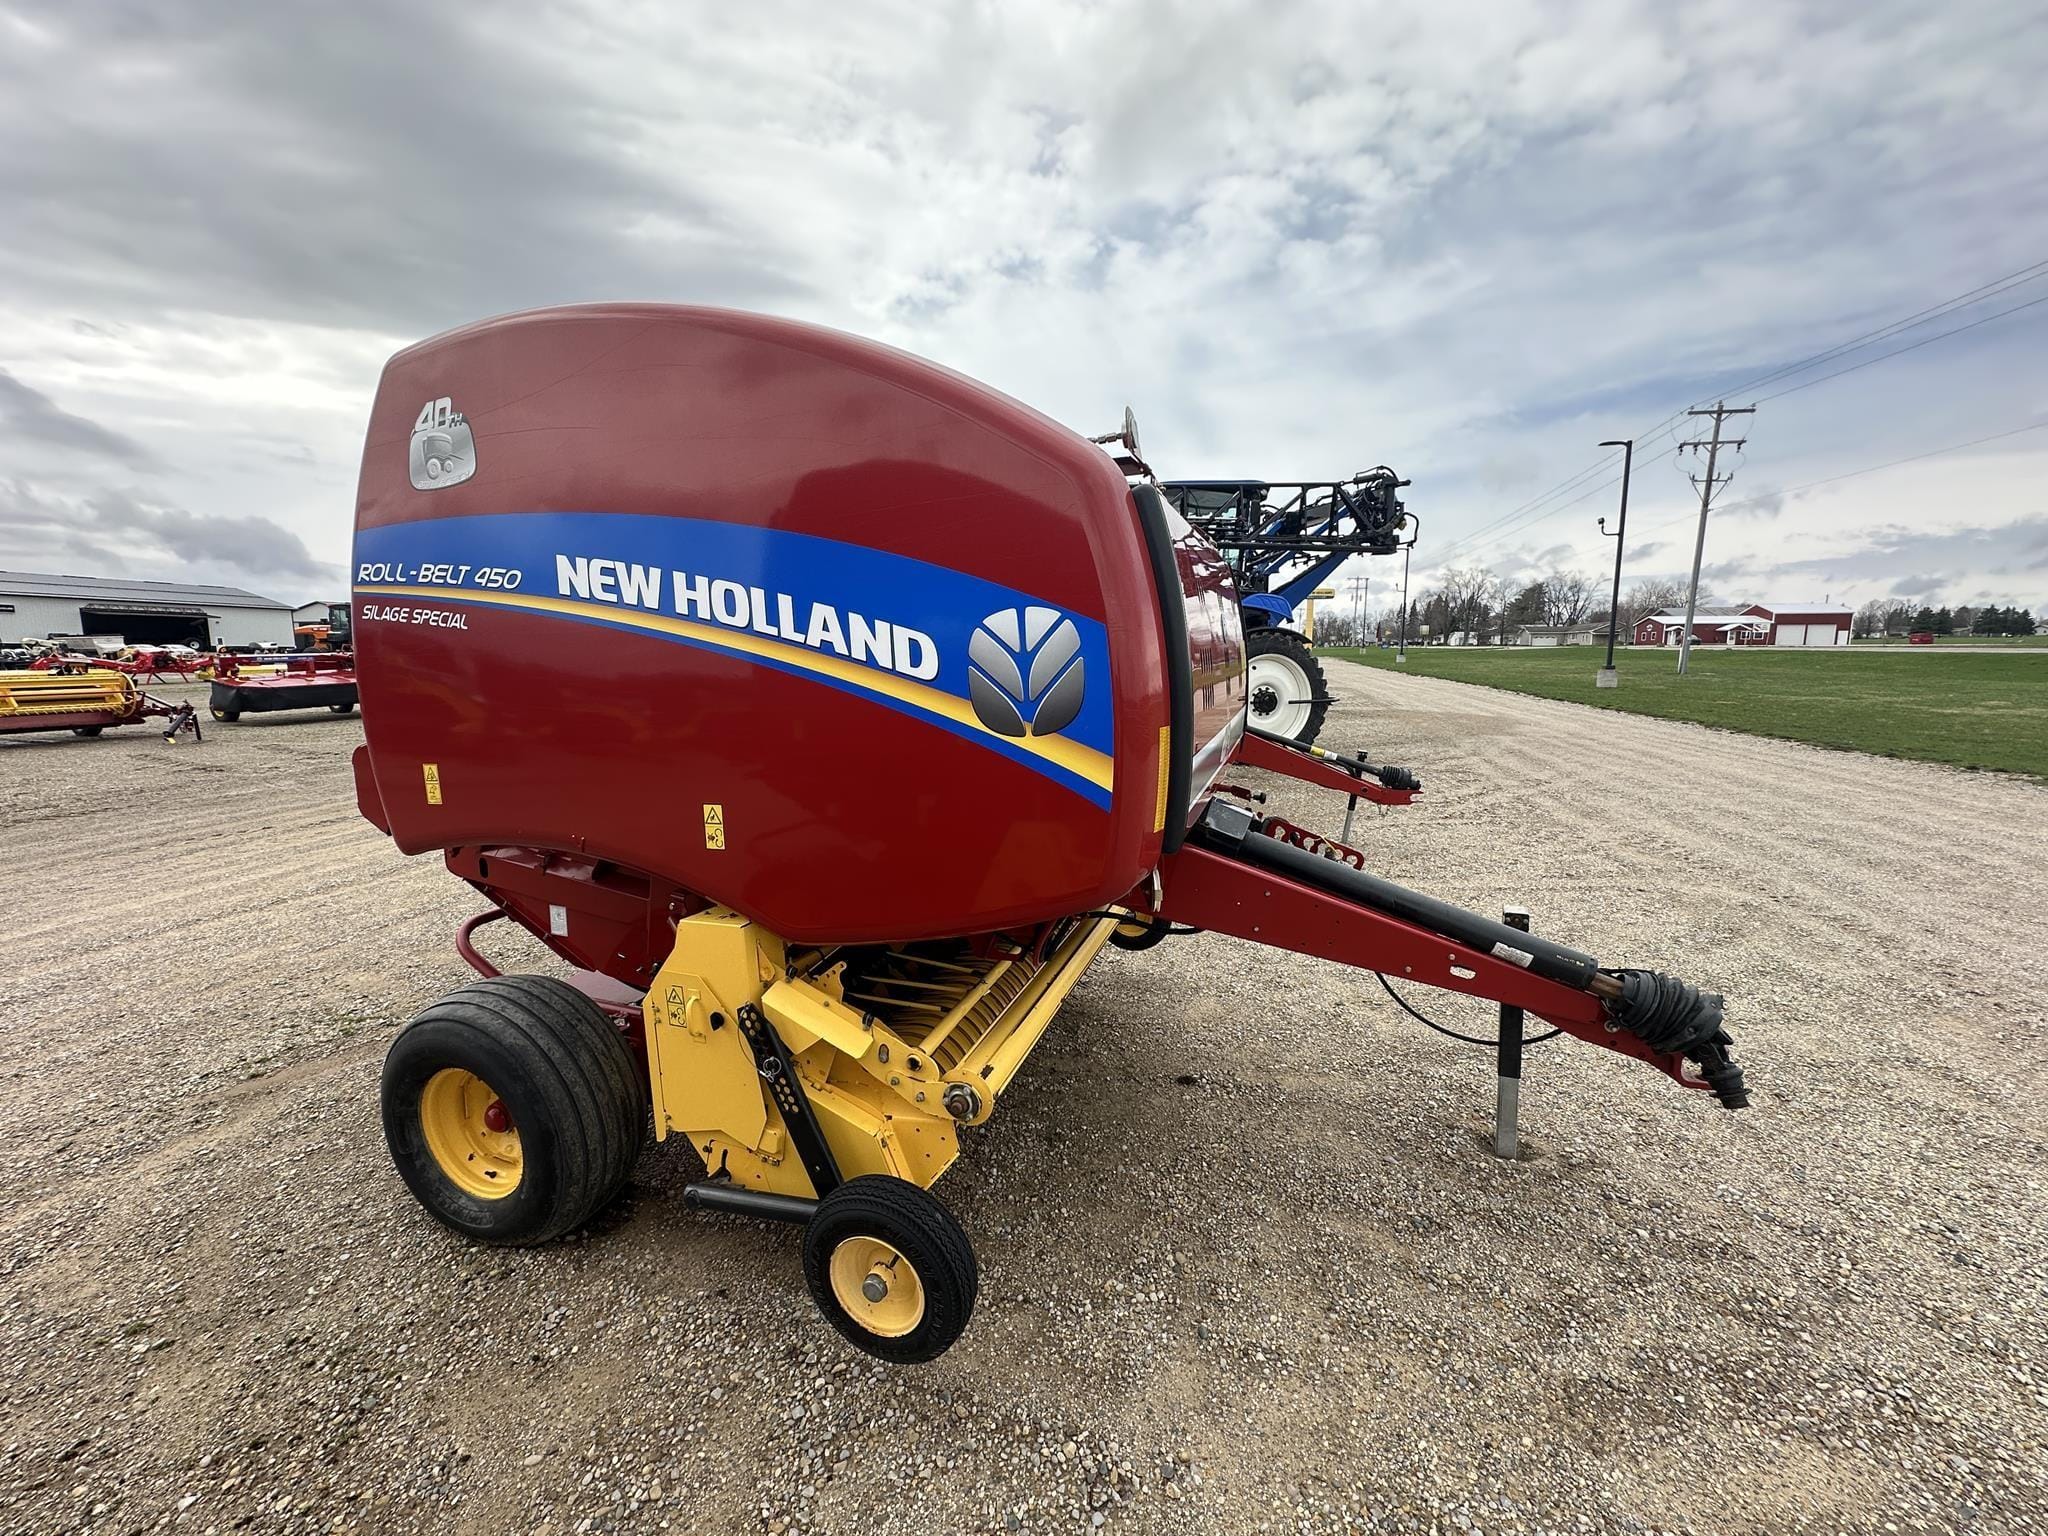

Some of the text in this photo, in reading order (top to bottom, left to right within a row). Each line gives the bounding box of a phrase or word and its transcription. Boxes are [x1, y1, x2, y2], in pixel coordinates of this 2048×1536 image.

[474, 567, 522, 589] 450
[361, 604, 469, 630] SILAGE SPECIAL
[554, 553, 939, 681] NEW HOLLAND
